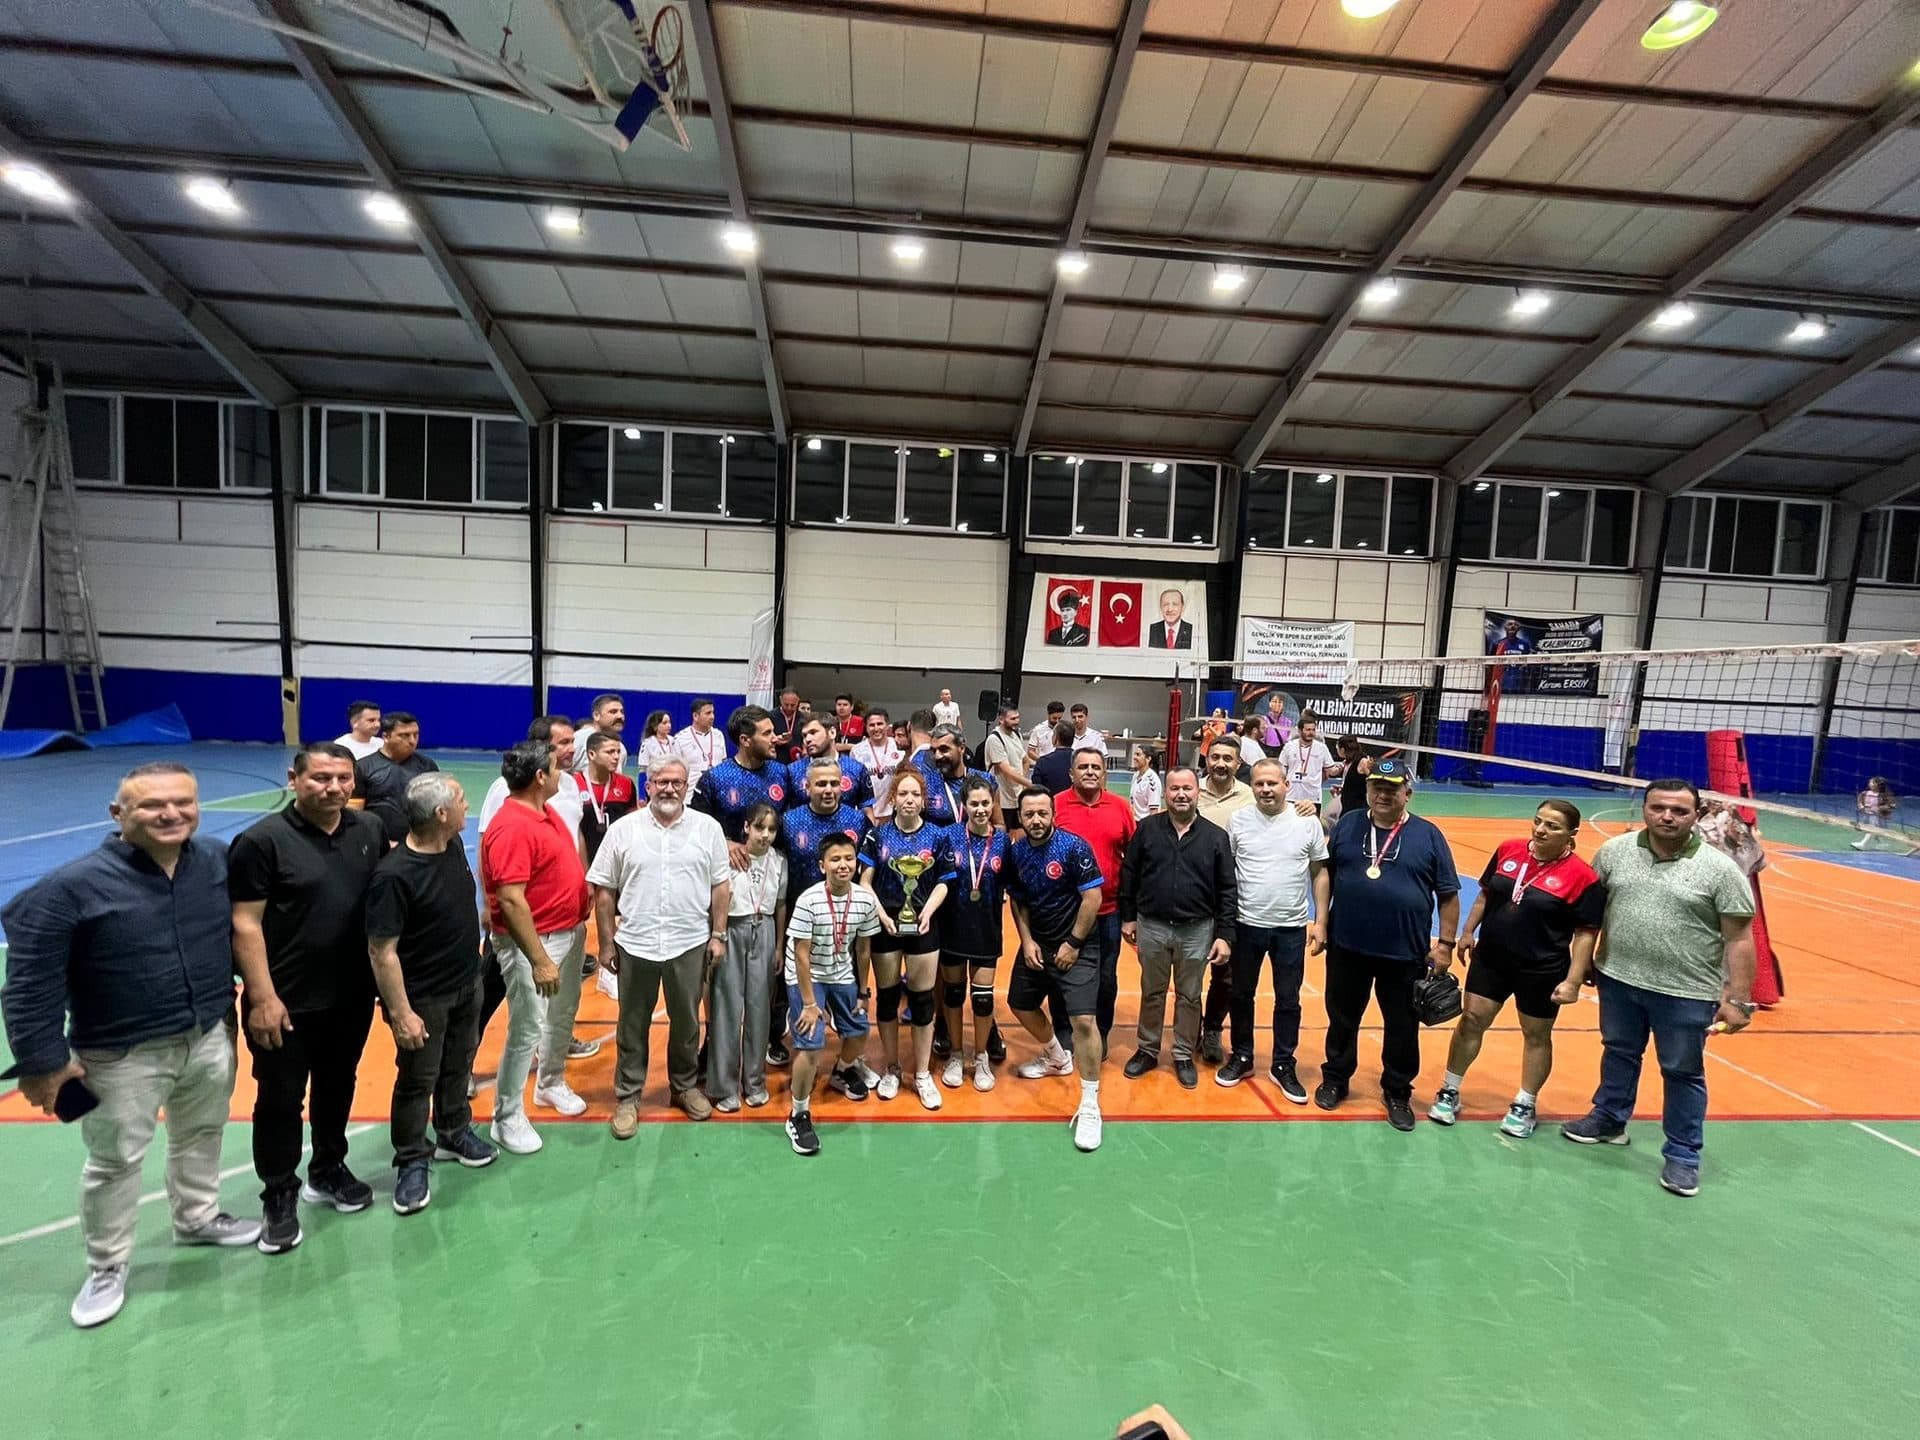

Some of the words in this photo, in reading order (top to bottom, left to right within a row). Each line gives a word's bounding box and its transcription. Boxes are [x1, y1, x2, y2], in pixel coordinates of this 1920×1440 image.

[1563, 678, 1589, 689] ERSOY
[1305, 698, 1394, 719] KALBİMİZDESİN
[1315, 719, 1349, 735] ANDAN
[1351, 721, 1385, 737] HOCAM
